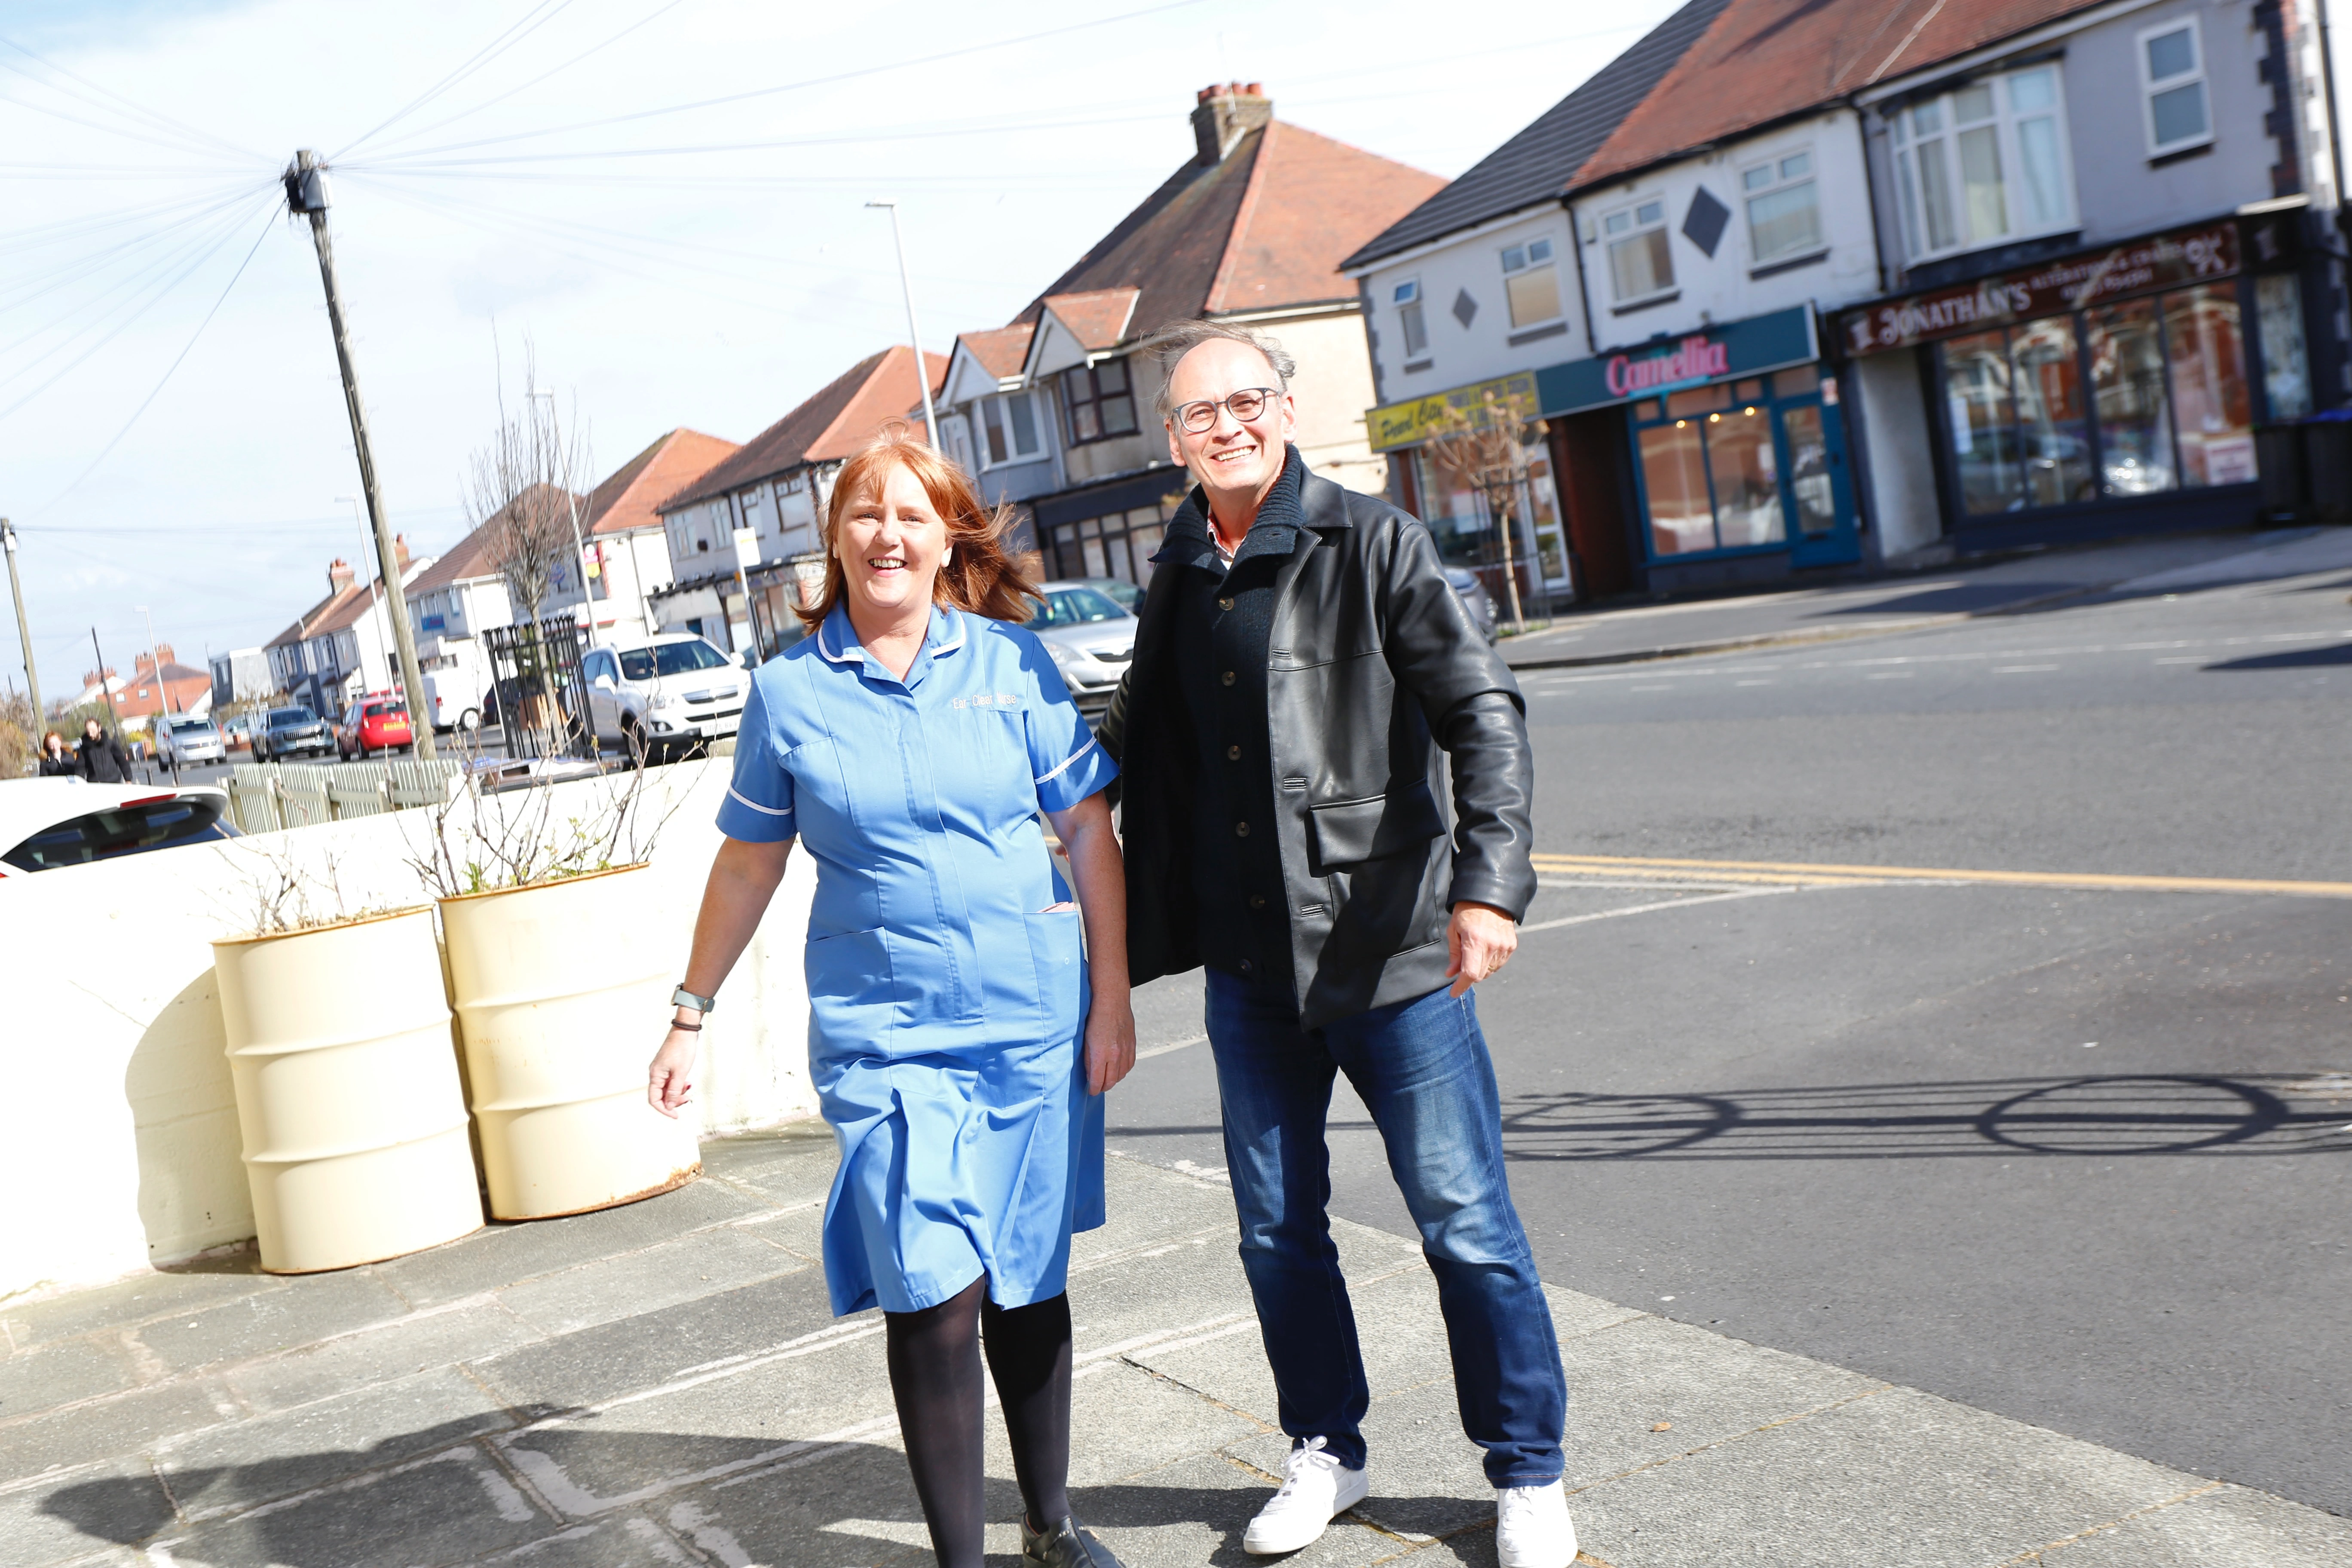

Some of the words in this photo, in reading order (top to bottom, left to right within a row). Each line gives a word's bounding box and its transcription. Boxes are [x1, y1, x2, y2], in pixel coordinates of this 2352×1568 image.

[1878, 280, 2032, 345] JONATHAN'S
[1605, 335, 1730, 397] Camellia
[953, 698, 966, 709] Ear
[972, 694, 992, 706] Clear
[997, 691, 1016, 705] Nurse
